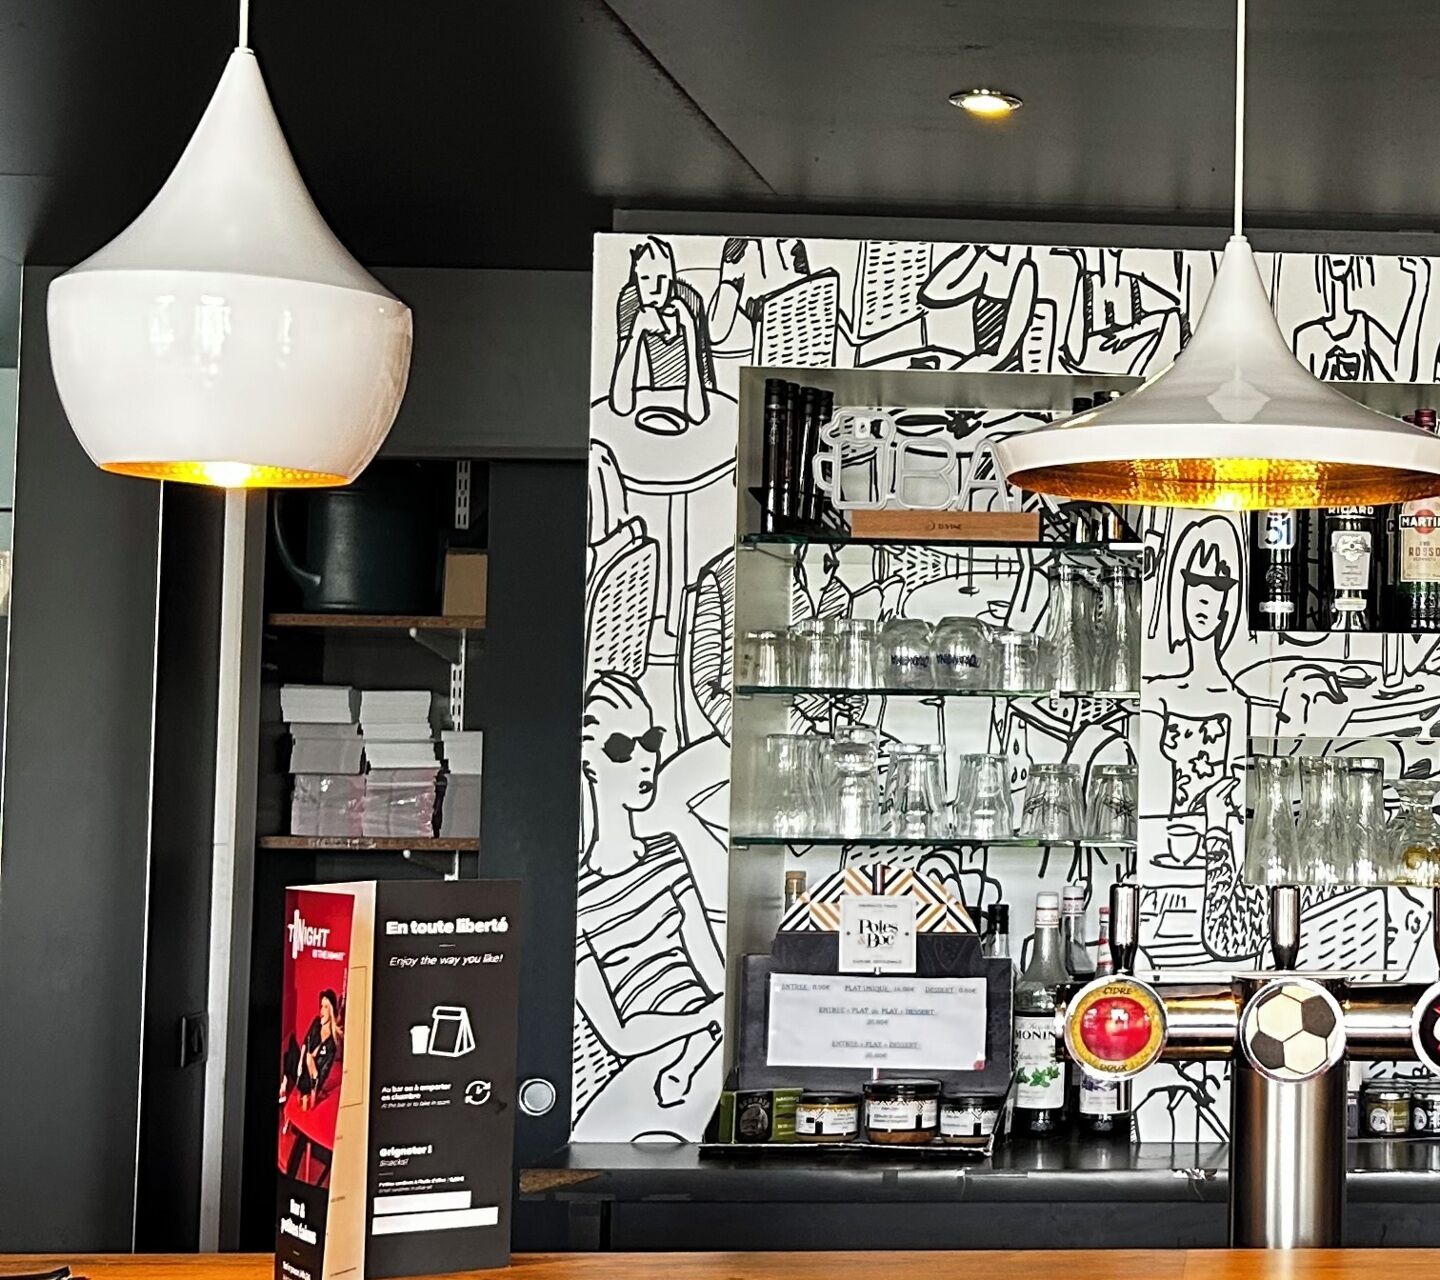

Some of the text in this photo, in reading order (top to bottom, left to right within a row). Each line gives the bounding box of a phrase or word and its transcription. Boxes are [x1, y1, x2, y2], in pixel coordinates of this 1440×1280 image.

[1328, 506, 1374, 515] RICARD
[1265, 517, 1291, 545] 51
[1408, 547, 1440, 557] ROSSO
[386, 916, 509, 935] En toute liberté
[389, 953, 504, 968] Enjoy the way you like!
[1103, 987, 1133, 995] CIDRE
[1015, 1028, 1056, 1040] MONIN
[1100, 1064, 1128, 1072] DOUX
[379, 1146, 427, 1158] Grignoter
